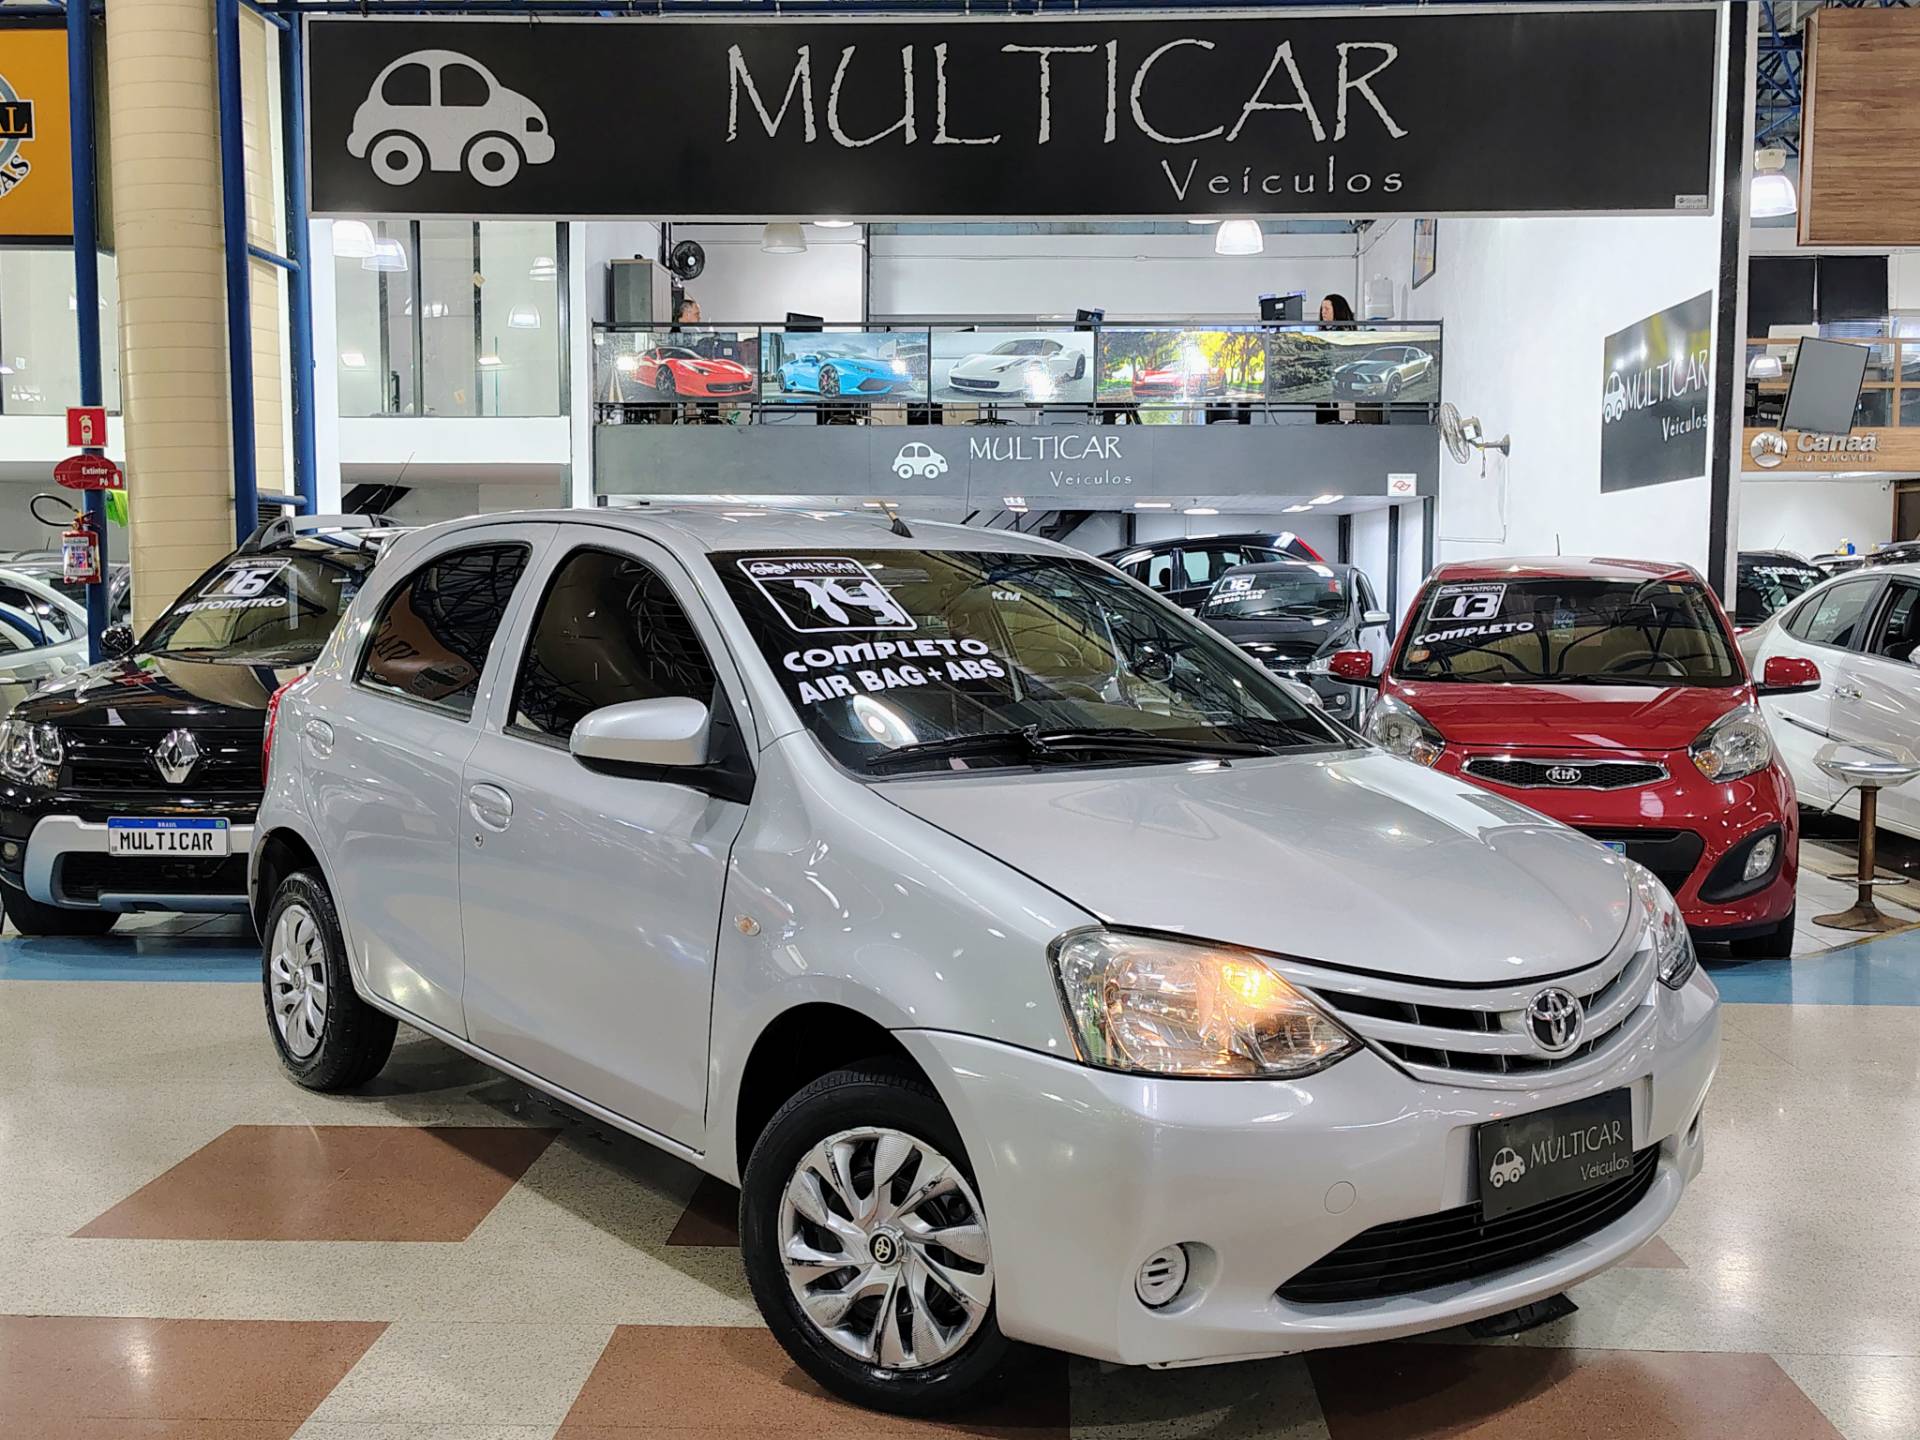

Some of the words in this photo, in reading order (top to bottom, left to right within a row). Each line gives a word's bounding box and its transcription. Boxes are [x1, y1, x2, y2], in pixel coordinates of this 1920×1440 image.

[726, 39, 1408, 147] MULTICAR
[1161, 155, 1403, 200] Veículos
[1625, 349, 1708, 412] MULTICAR
[970, 435, 1122, 461] MULTICAR
[785, 562, 857, 571] MULTICAR
[223, 570, 273, 595] 16
[991, 591, 1021, 601] KM
[1451, 594, 1499, 617] 13
[1413, 622, 1534, 646] COMPLETO
[783, 639, 989, 672] COMPLETO
[798, 674, 858, 705] AIR
[944, 659, 1006, 681] ABS
[1551, 769, 1576, 780] KIA
[120, 832, 213, 851] MULTICAR
[1530, 1120, 1624, 1169] MULTICAR
